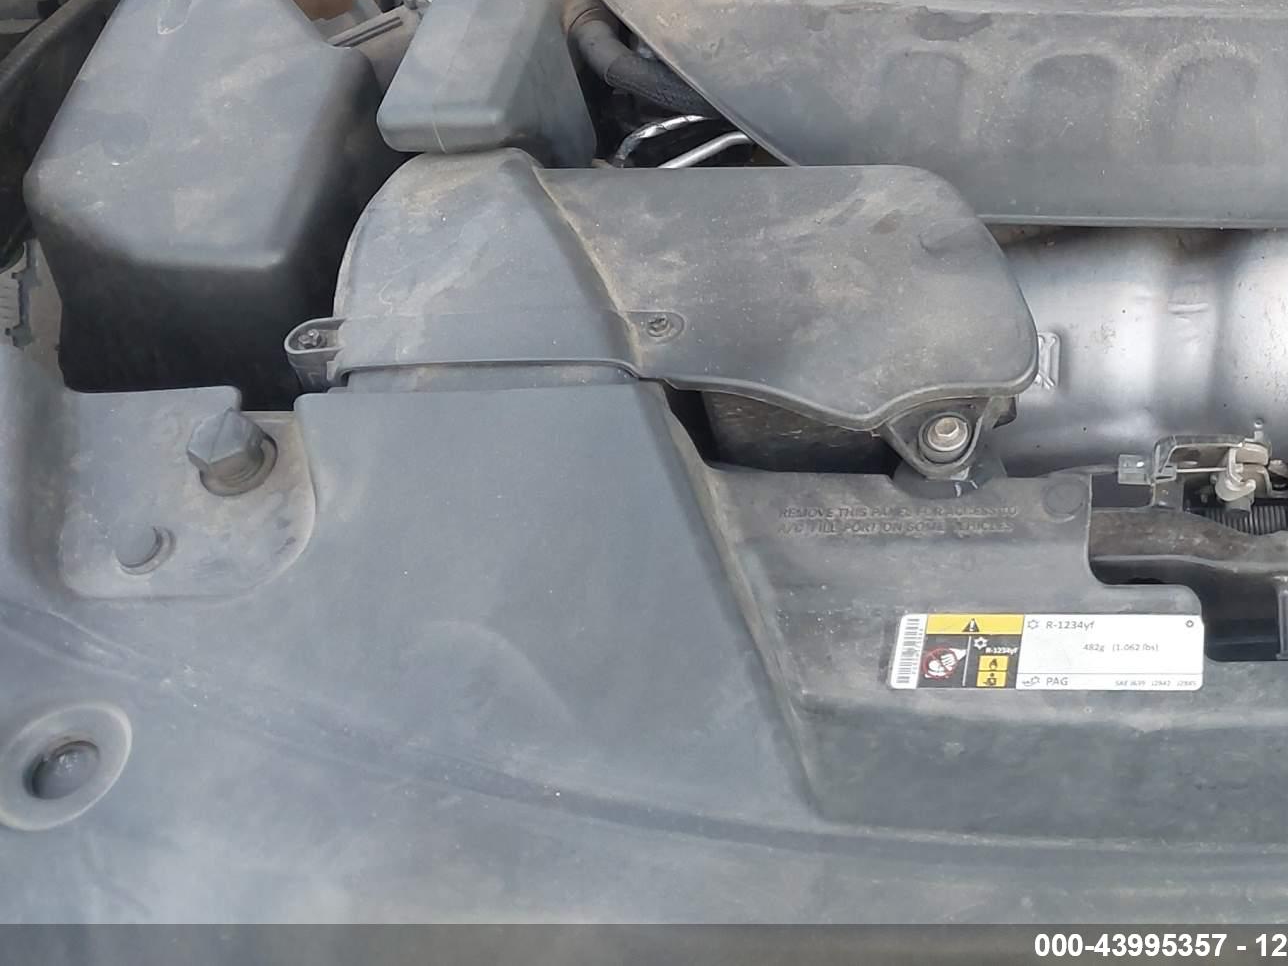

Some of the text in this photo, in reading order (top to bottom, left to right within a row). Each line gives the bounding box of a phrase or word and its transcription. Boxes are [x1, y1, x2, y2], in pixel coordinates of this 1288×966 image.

[839, 505, 867, 518] THIS
[1046, 620, 1095, 631] R-1234yf
[1046, 677, 1068, 687] PAG
